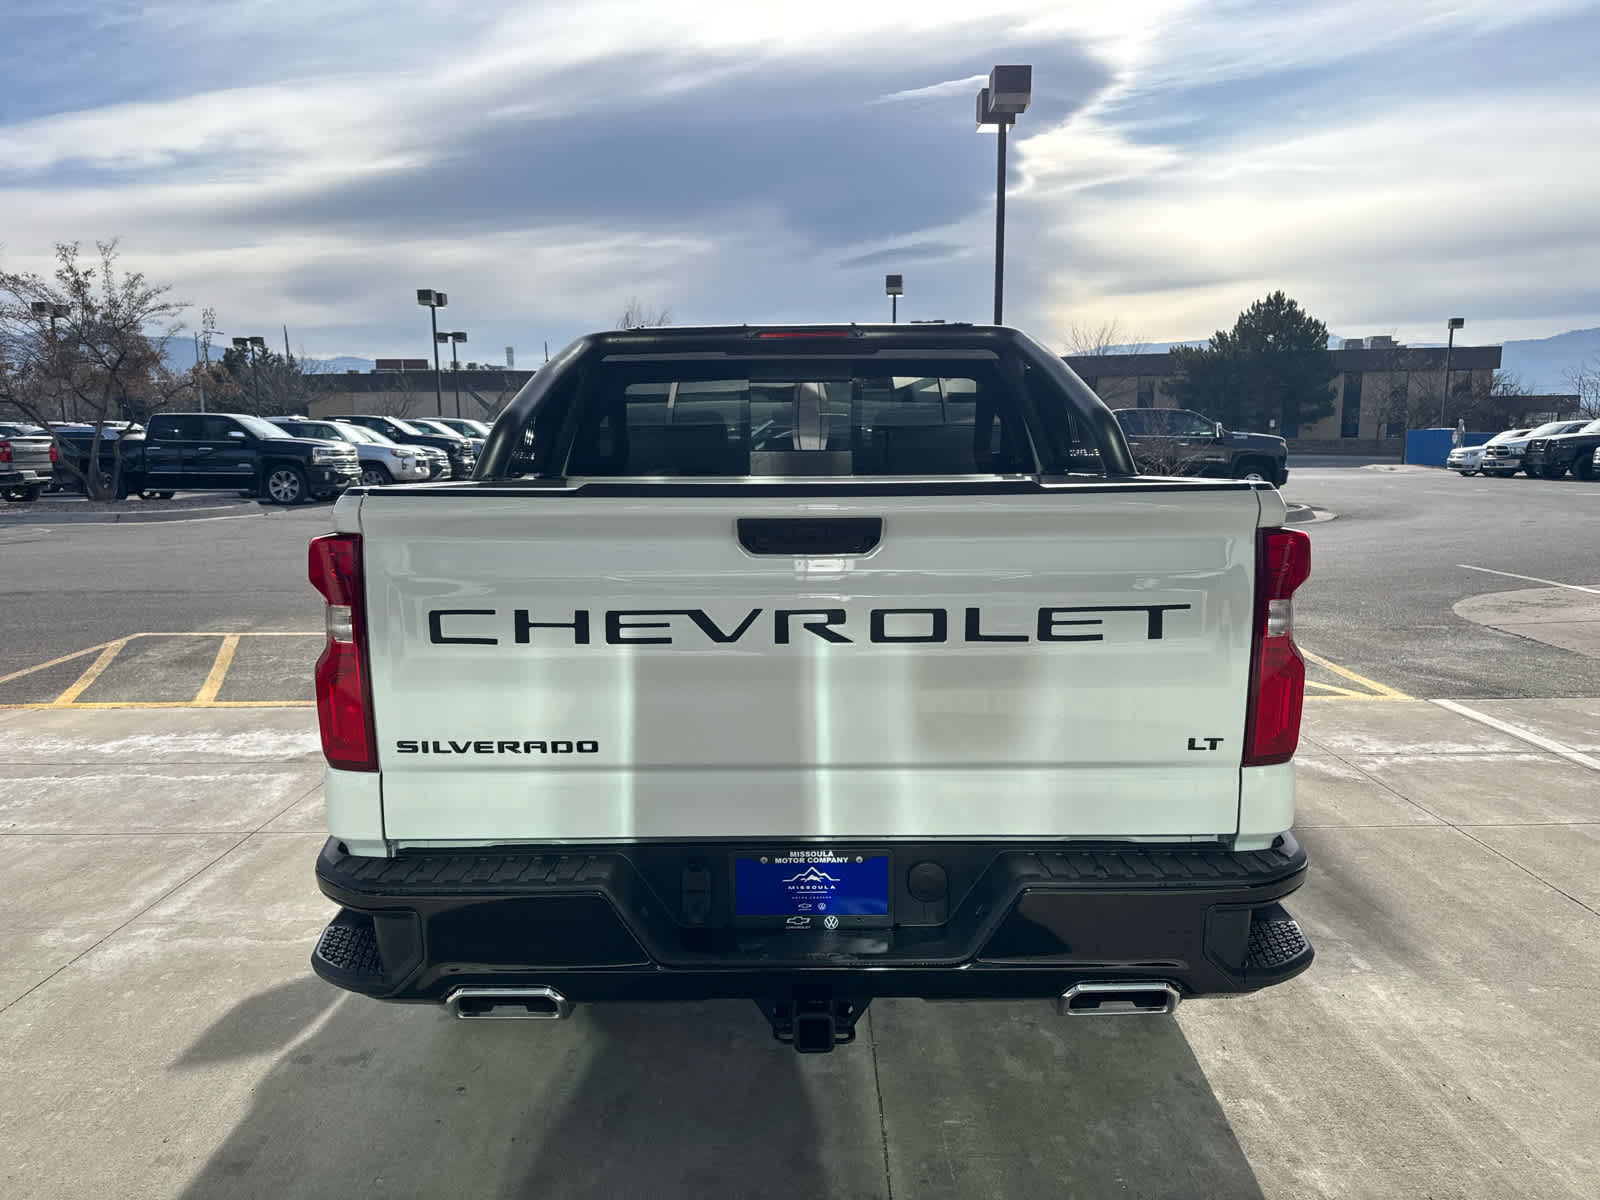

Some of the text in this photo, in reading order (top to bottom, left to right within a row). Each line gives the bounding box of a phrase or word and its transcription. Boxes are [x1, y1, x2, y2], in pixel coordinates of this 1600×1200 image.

[429, 604, 1191, 645] CHEVROLET
[397, 740, 599, 754] SILVERADO
[1187, 737, 1224, 751] LT
[807, 856, 849, 864] COMPANY
